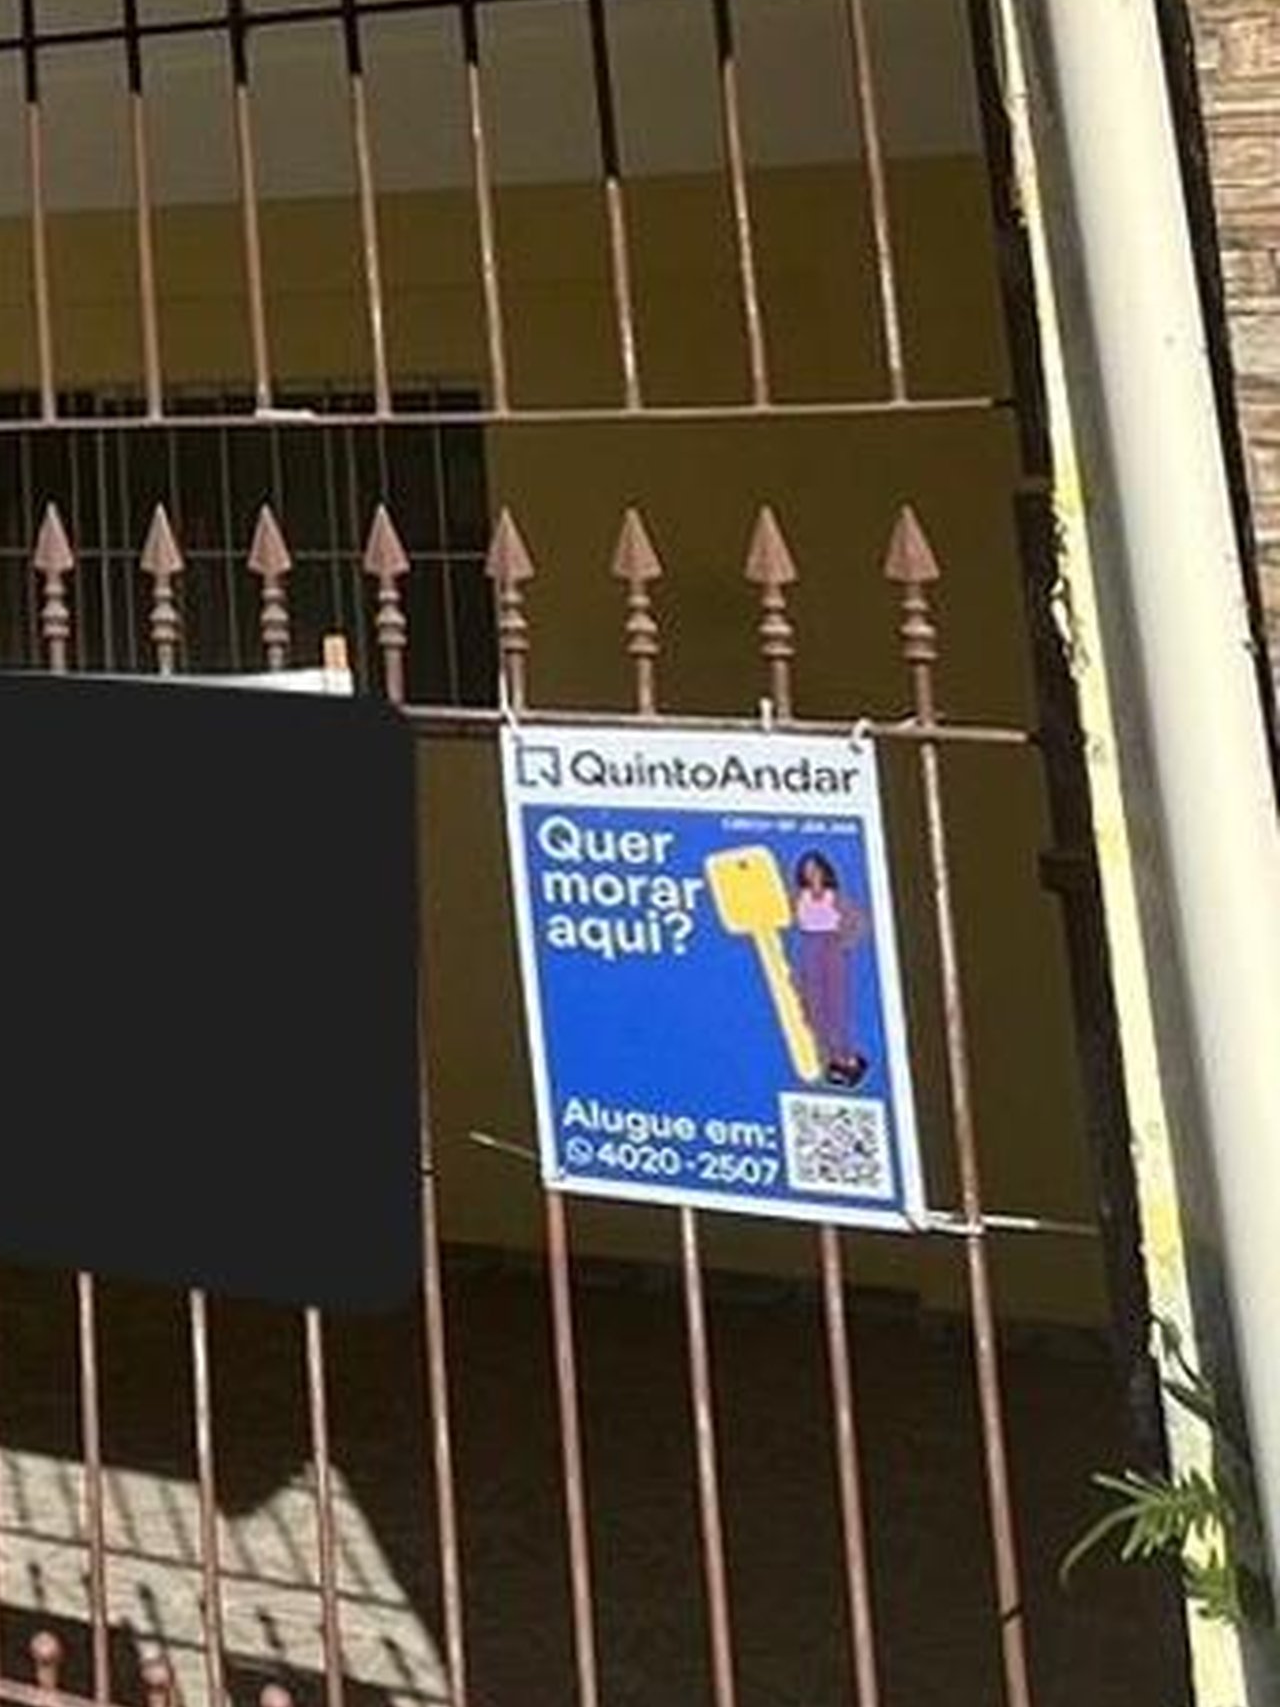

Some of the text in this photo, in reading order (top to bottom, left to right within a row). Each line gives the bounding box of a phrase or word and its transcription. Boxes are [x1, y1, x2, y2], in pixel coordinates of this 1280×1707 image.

[569, 750, 859, 794] QuintoAndar
[539, 816, 674, 864] Quer
[543, 870, 704, 909] morar
[548, 912, 694, 961] aqui?
[562, 1098, 778, 1149] Alugue em:
